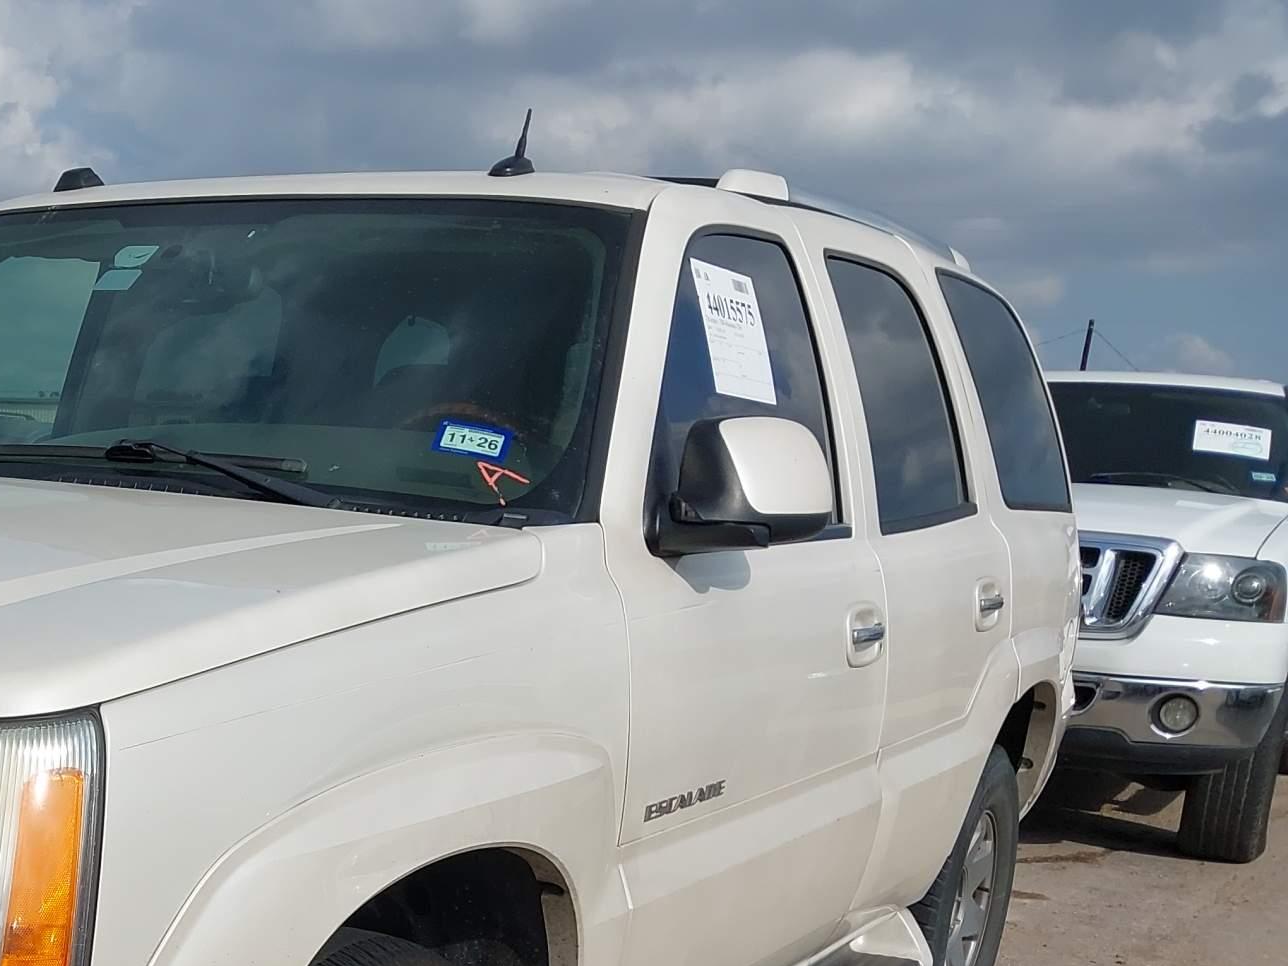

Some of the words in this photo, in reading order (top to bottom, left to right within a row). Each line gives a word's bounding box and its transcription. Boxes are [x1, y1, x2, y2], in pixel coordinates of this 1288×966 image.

[706, 292, 756, 327] 44015575
[476, 436, 500, 451] 26
[643, 779, 727, 823] ESCALADE
